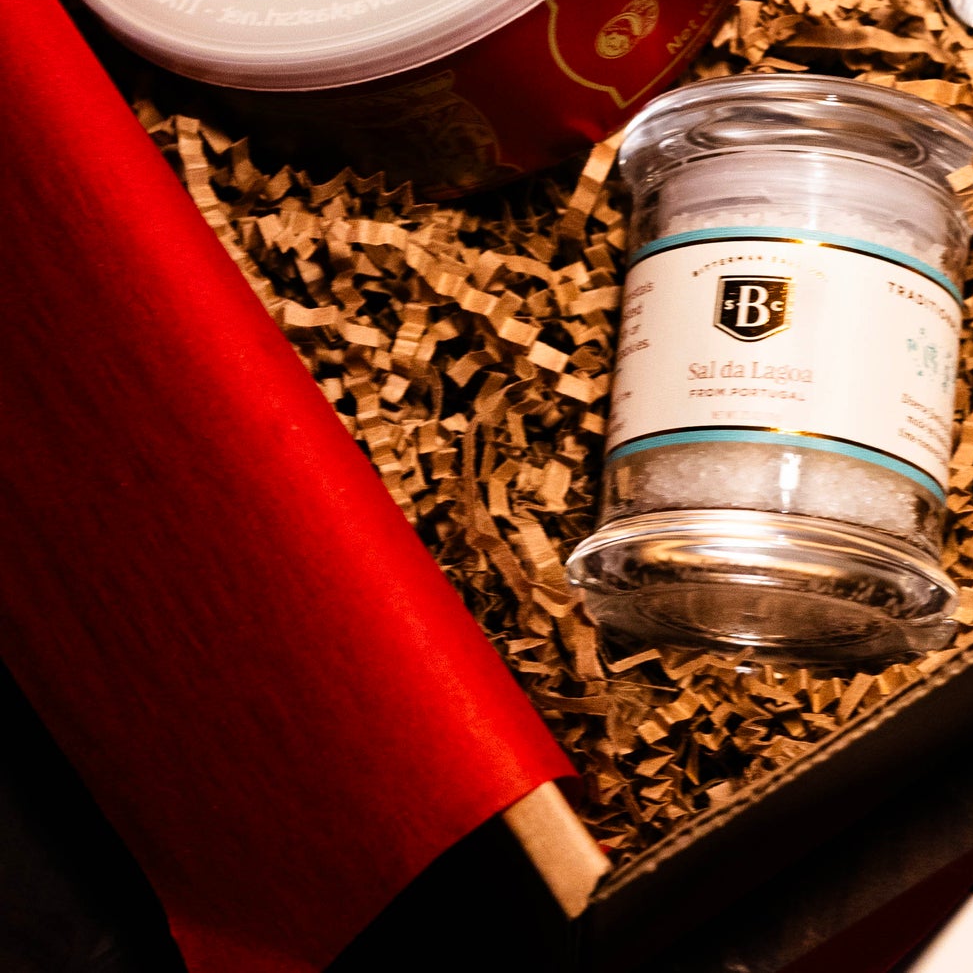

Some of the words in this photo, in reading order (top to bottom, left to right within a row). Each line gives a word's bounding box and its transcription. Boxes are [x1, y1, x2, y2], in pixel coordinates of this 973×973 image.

[686, 360, 717, 381] Sal
[719, 360, 746, 379] da
[750, 361, 816, 385] Lagoa
[688, 387, 726, 398] FROM
[729, 387, 806, 402] PORTUGAL
